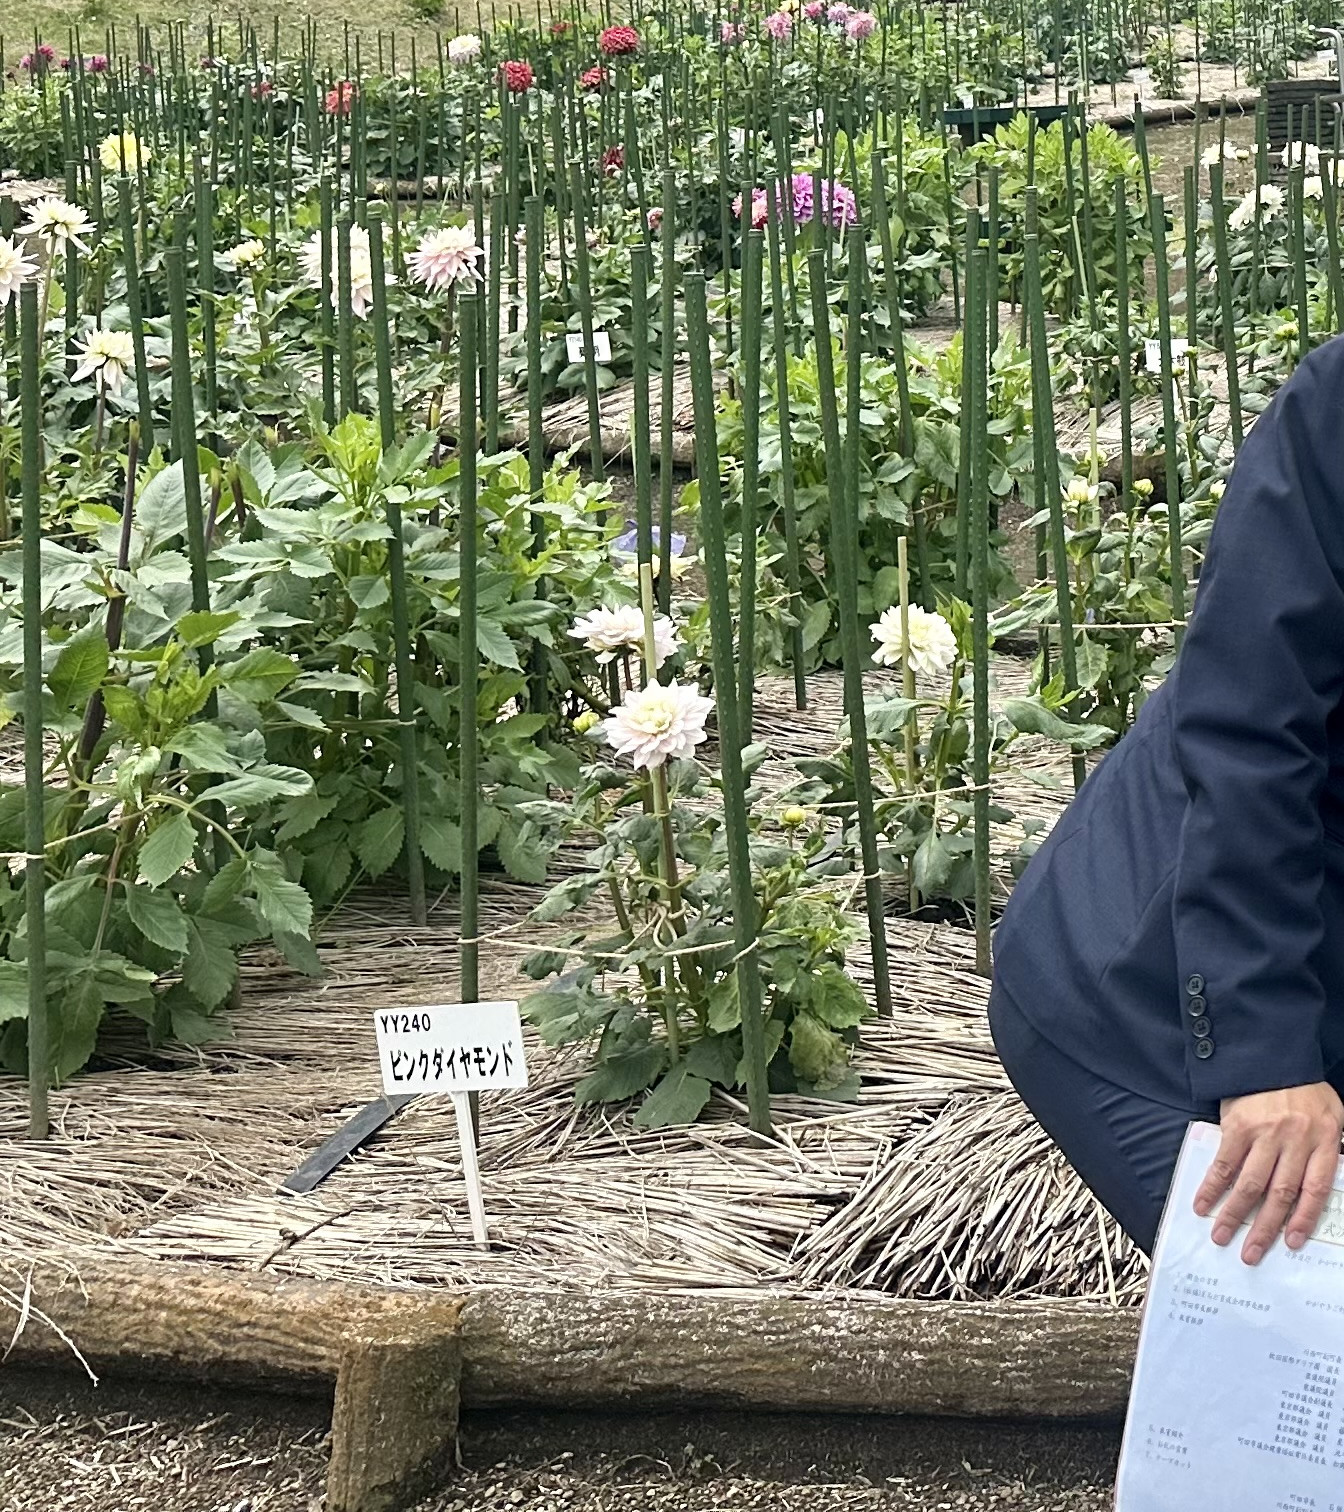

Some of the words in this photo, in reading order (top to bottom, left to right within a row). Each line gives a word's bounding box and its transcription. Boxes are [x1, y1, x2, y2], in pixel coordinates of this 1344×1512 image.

[379, 1013, 431, 1034] YY240
[389, 1040, 513, 1081] ピンクダイヤモンド
